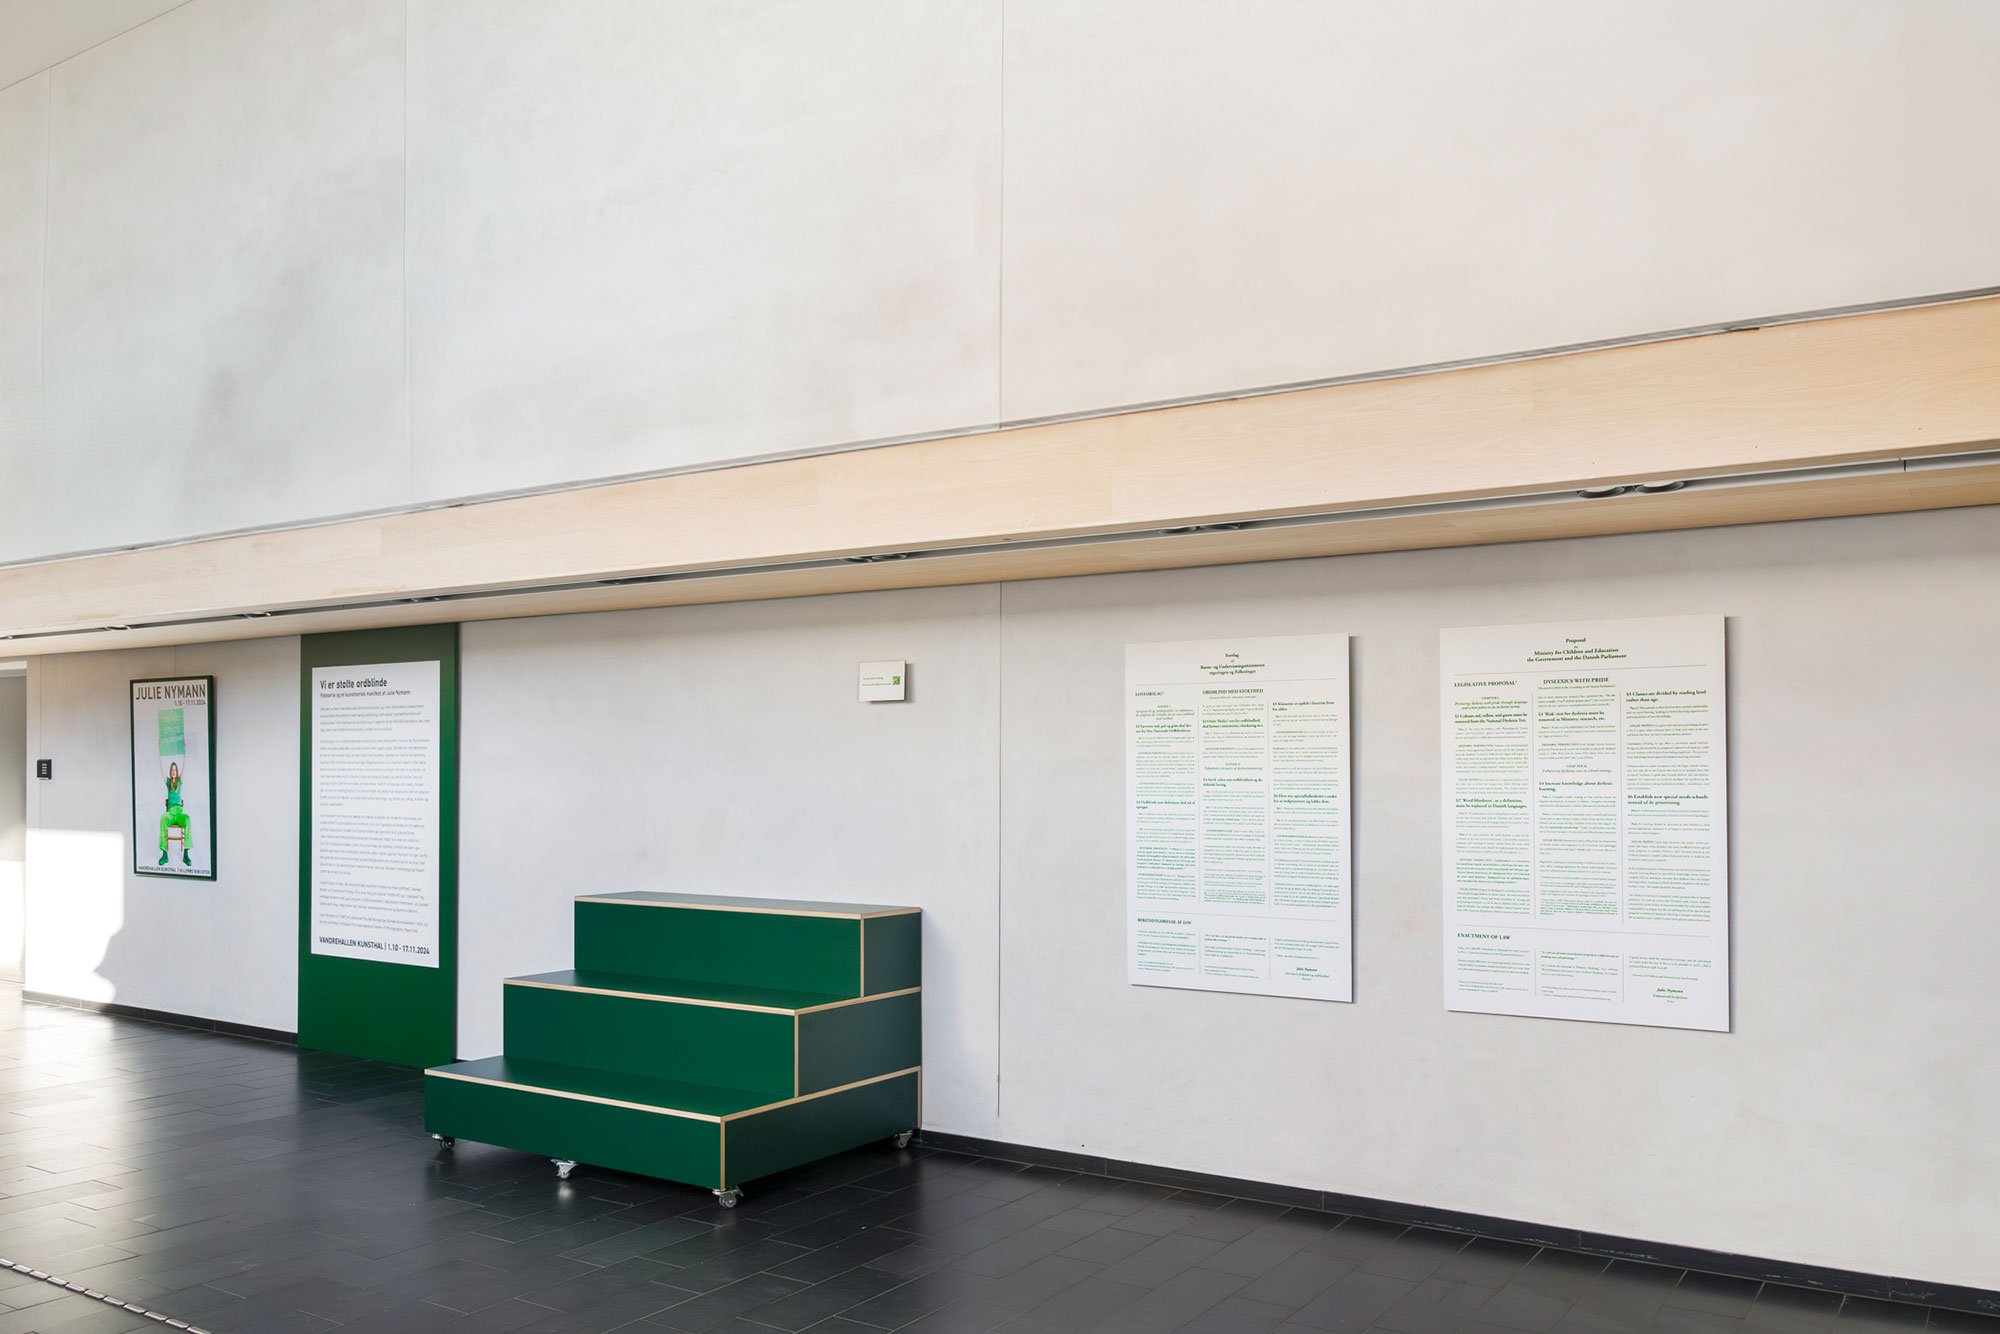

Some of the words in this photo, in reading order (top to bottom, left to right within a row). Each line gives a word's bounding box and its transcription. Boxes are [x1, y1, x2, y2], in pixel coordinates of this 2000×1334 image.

[320, 680, 326, 689] Vi
[337, 680, 354, 689] stolte
[356, 678, 387, 688] ordblinde
[136, 686, 162, 700] JULIE
[164, 684, 206, 698] NYMANN
[319, 936, 356, 947] VANDREHALLEN
[357, 941, 383, 950] KUNSTHAL
[402, 945, 430, 955] 17.11.2024
